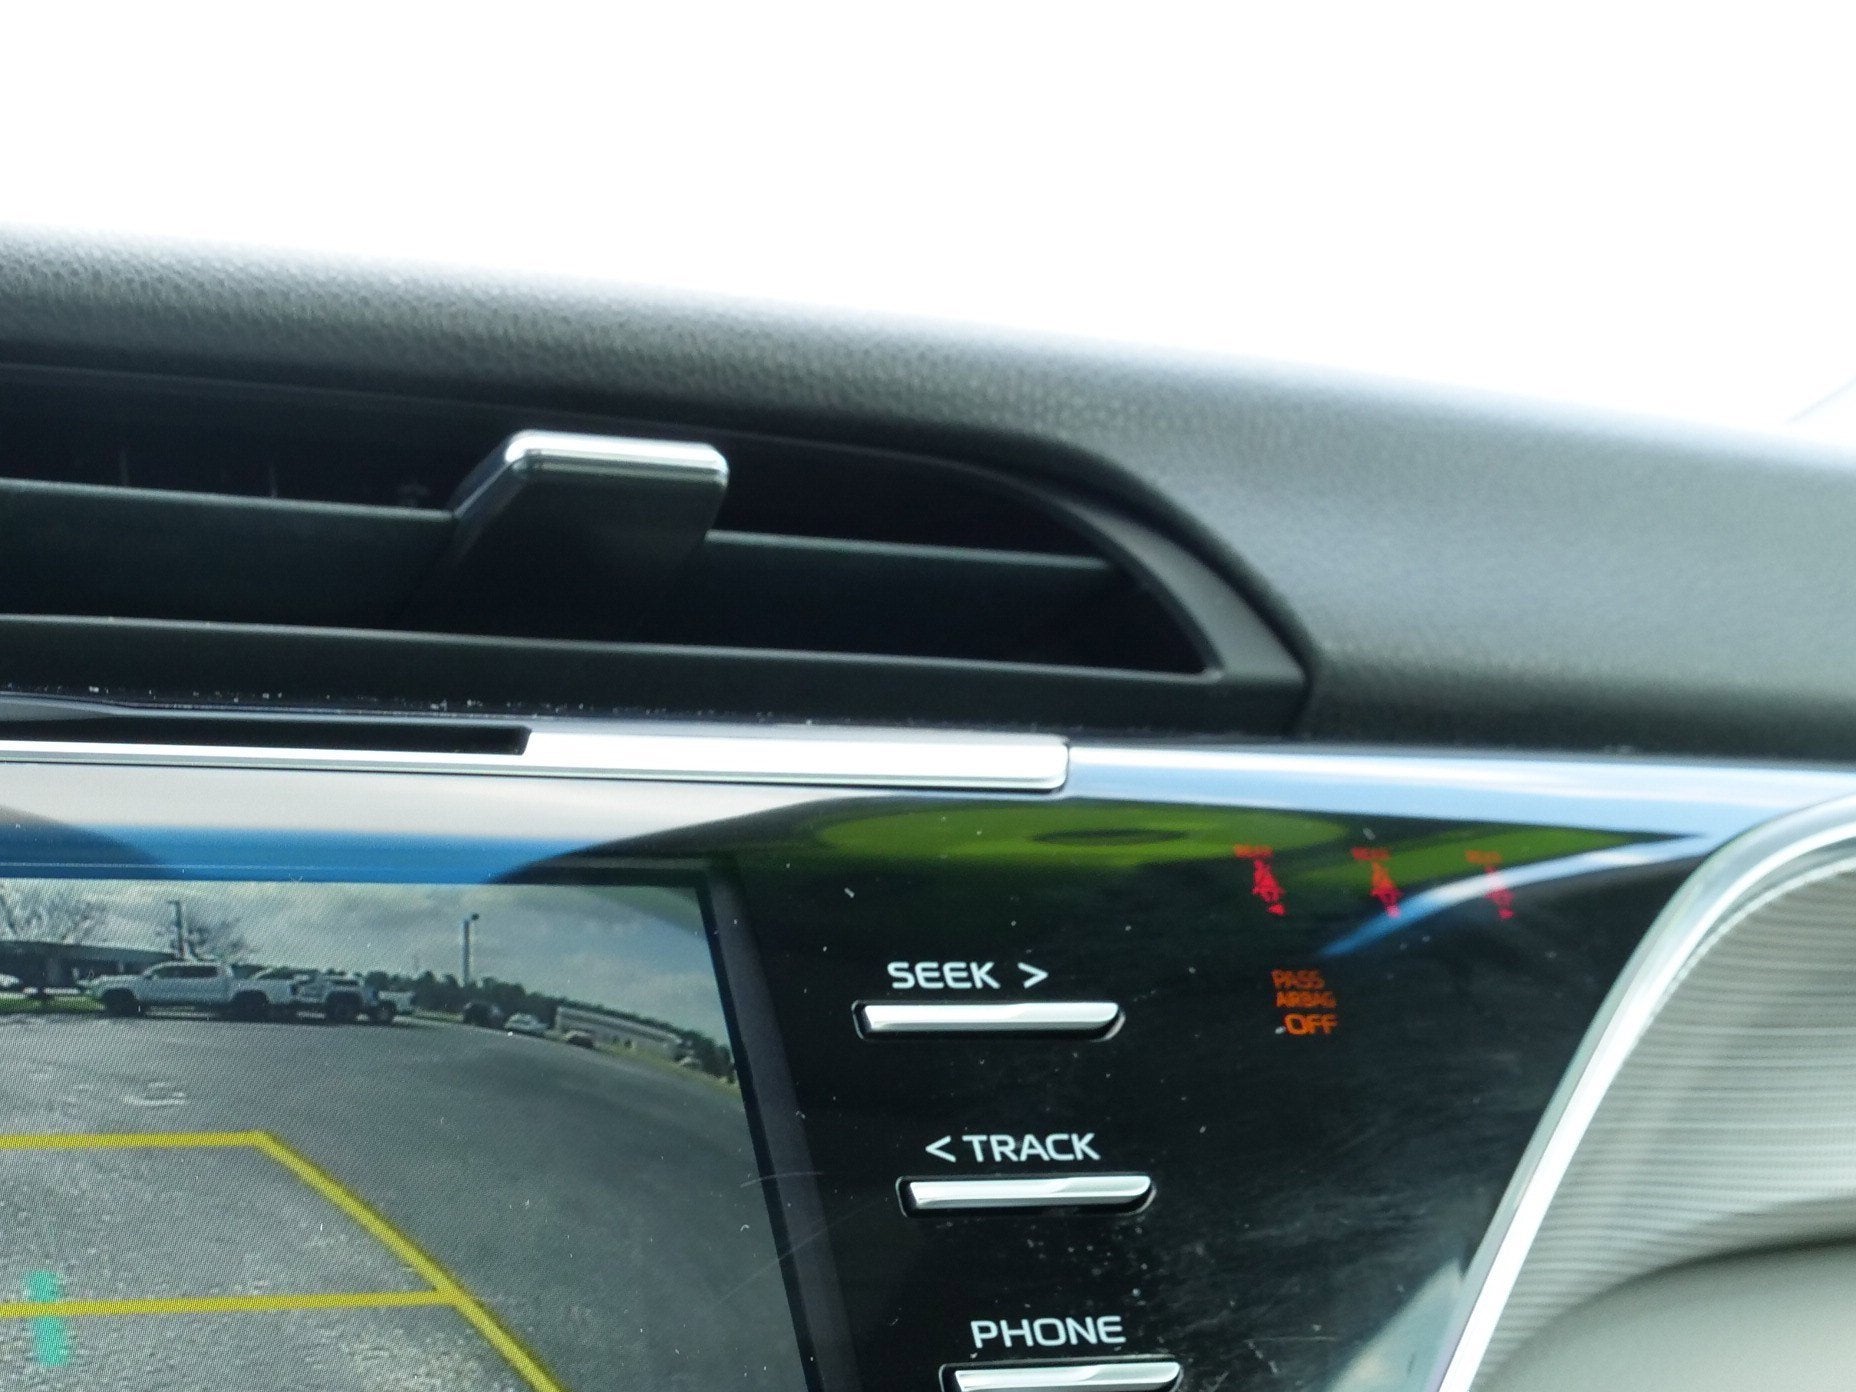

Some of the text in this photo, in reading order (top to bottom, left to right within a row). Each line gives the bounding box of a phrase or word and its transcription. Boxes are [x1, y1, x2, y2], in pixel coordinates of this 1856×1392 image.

[887, 961, 1000, 989] SEEK
[1284, 1013, 1338, 1035] OFF
[962, 1132, 1100, 1162] TRACK
[970, 1315, 1126, 1349] PHONE
